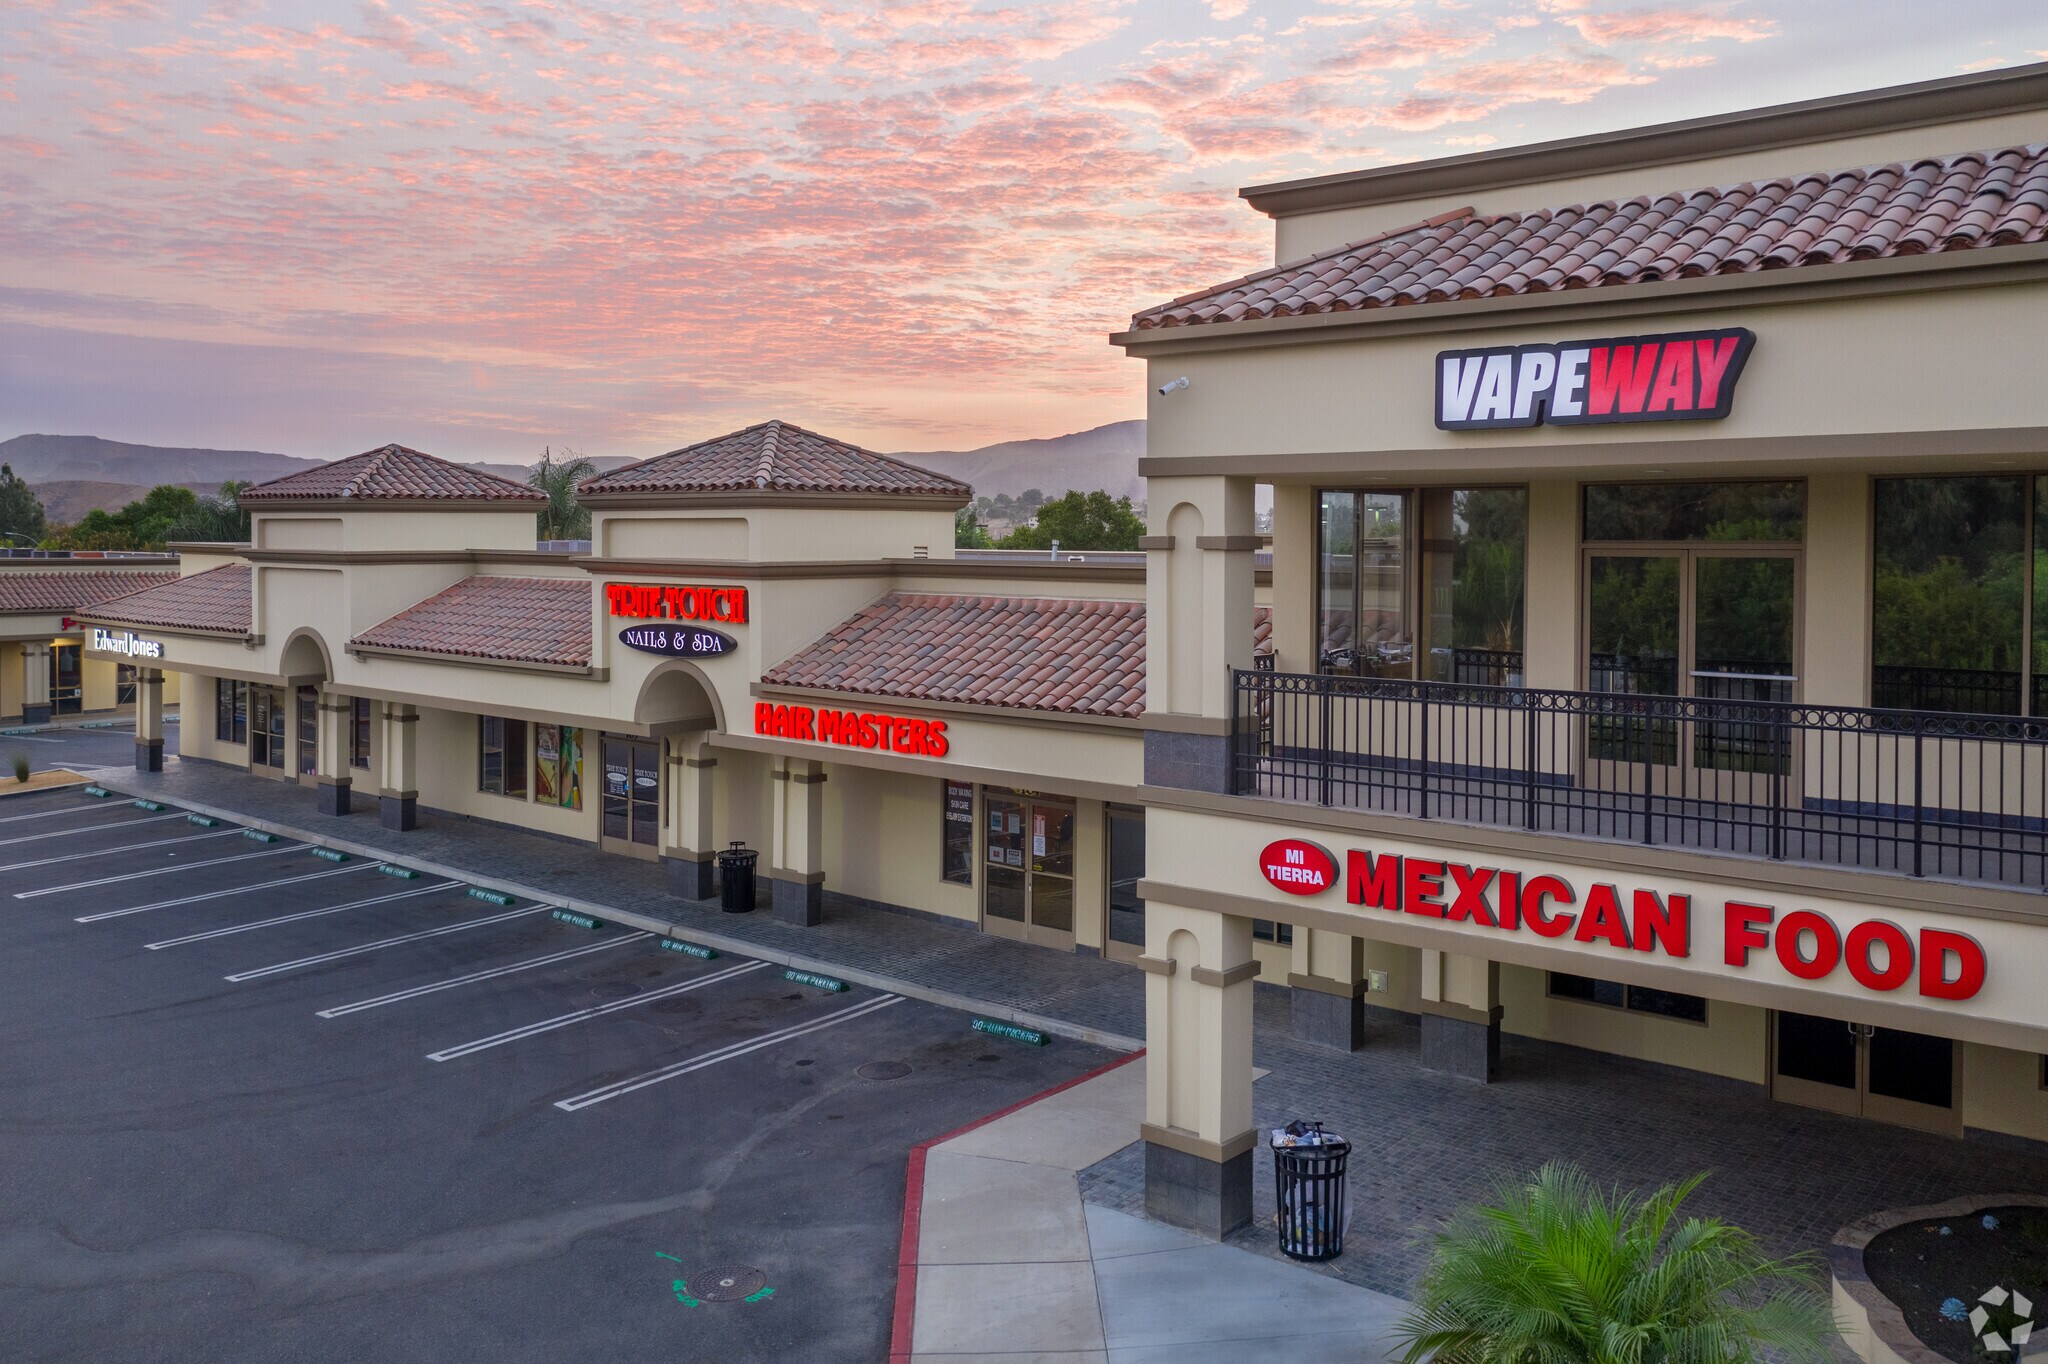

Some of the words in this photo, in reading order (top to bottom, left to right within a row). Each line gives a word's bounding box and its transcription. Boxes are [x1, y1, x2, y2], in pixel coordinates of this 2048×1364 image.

[1442, 336, 1740, 422] VAPEWAY
[606, 583, 661, 618] TRUE
[665, 586, 745, 624] TOUCH
[95, 628, 128, 654] Edward
[128, 633, 160, 657] Jones
[626, 631, 667, 648] NAILS
[673, 632, 686, 650] &
[692, 634, 723, 651] SPA
[755, 702, 815, 741] HAIR
[818, 709, 949, 758] MASTERS
[1285, 848, 1304, 865] MI
[1267, 865, 1325, 885] TIERRA
[1347, 848, 1692, 958] MEXICAN
[1724, 900, 1988, 1001] FOOD
